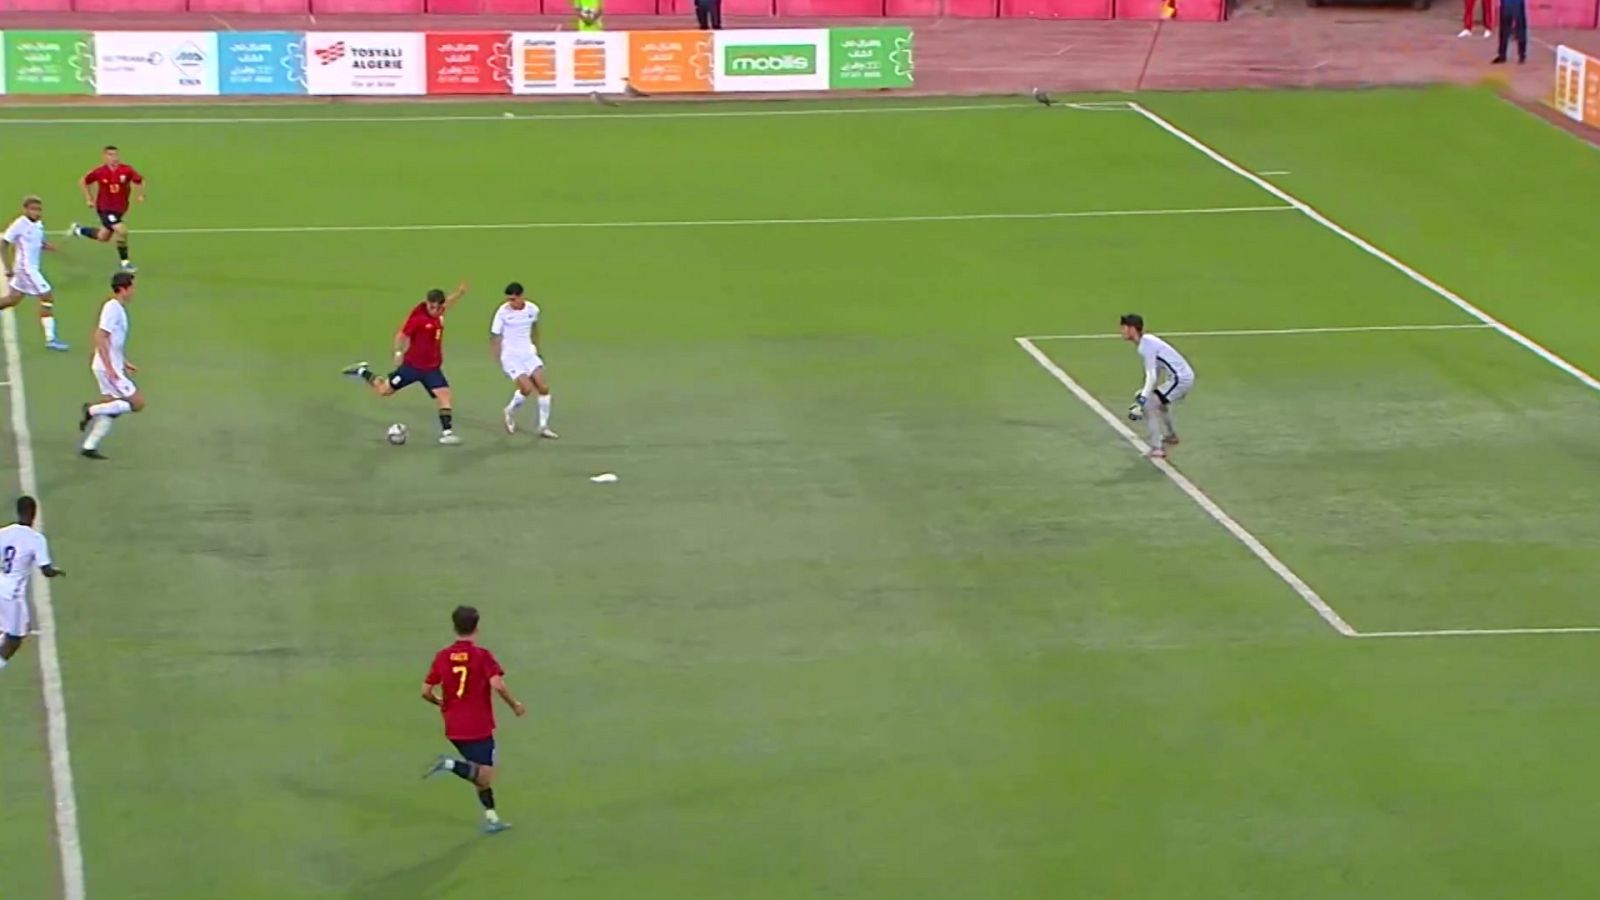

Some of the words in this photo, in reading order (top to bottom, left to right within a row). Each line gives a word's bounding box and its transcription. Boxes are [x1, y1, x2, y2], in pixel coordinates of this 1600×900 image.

[351, 47, 403, 57] TOSYALI
[352, 60, 403, 69] ALGERIE
[732, 54, 809, 71] mobilis
[452, 666, 468, 698] 7
